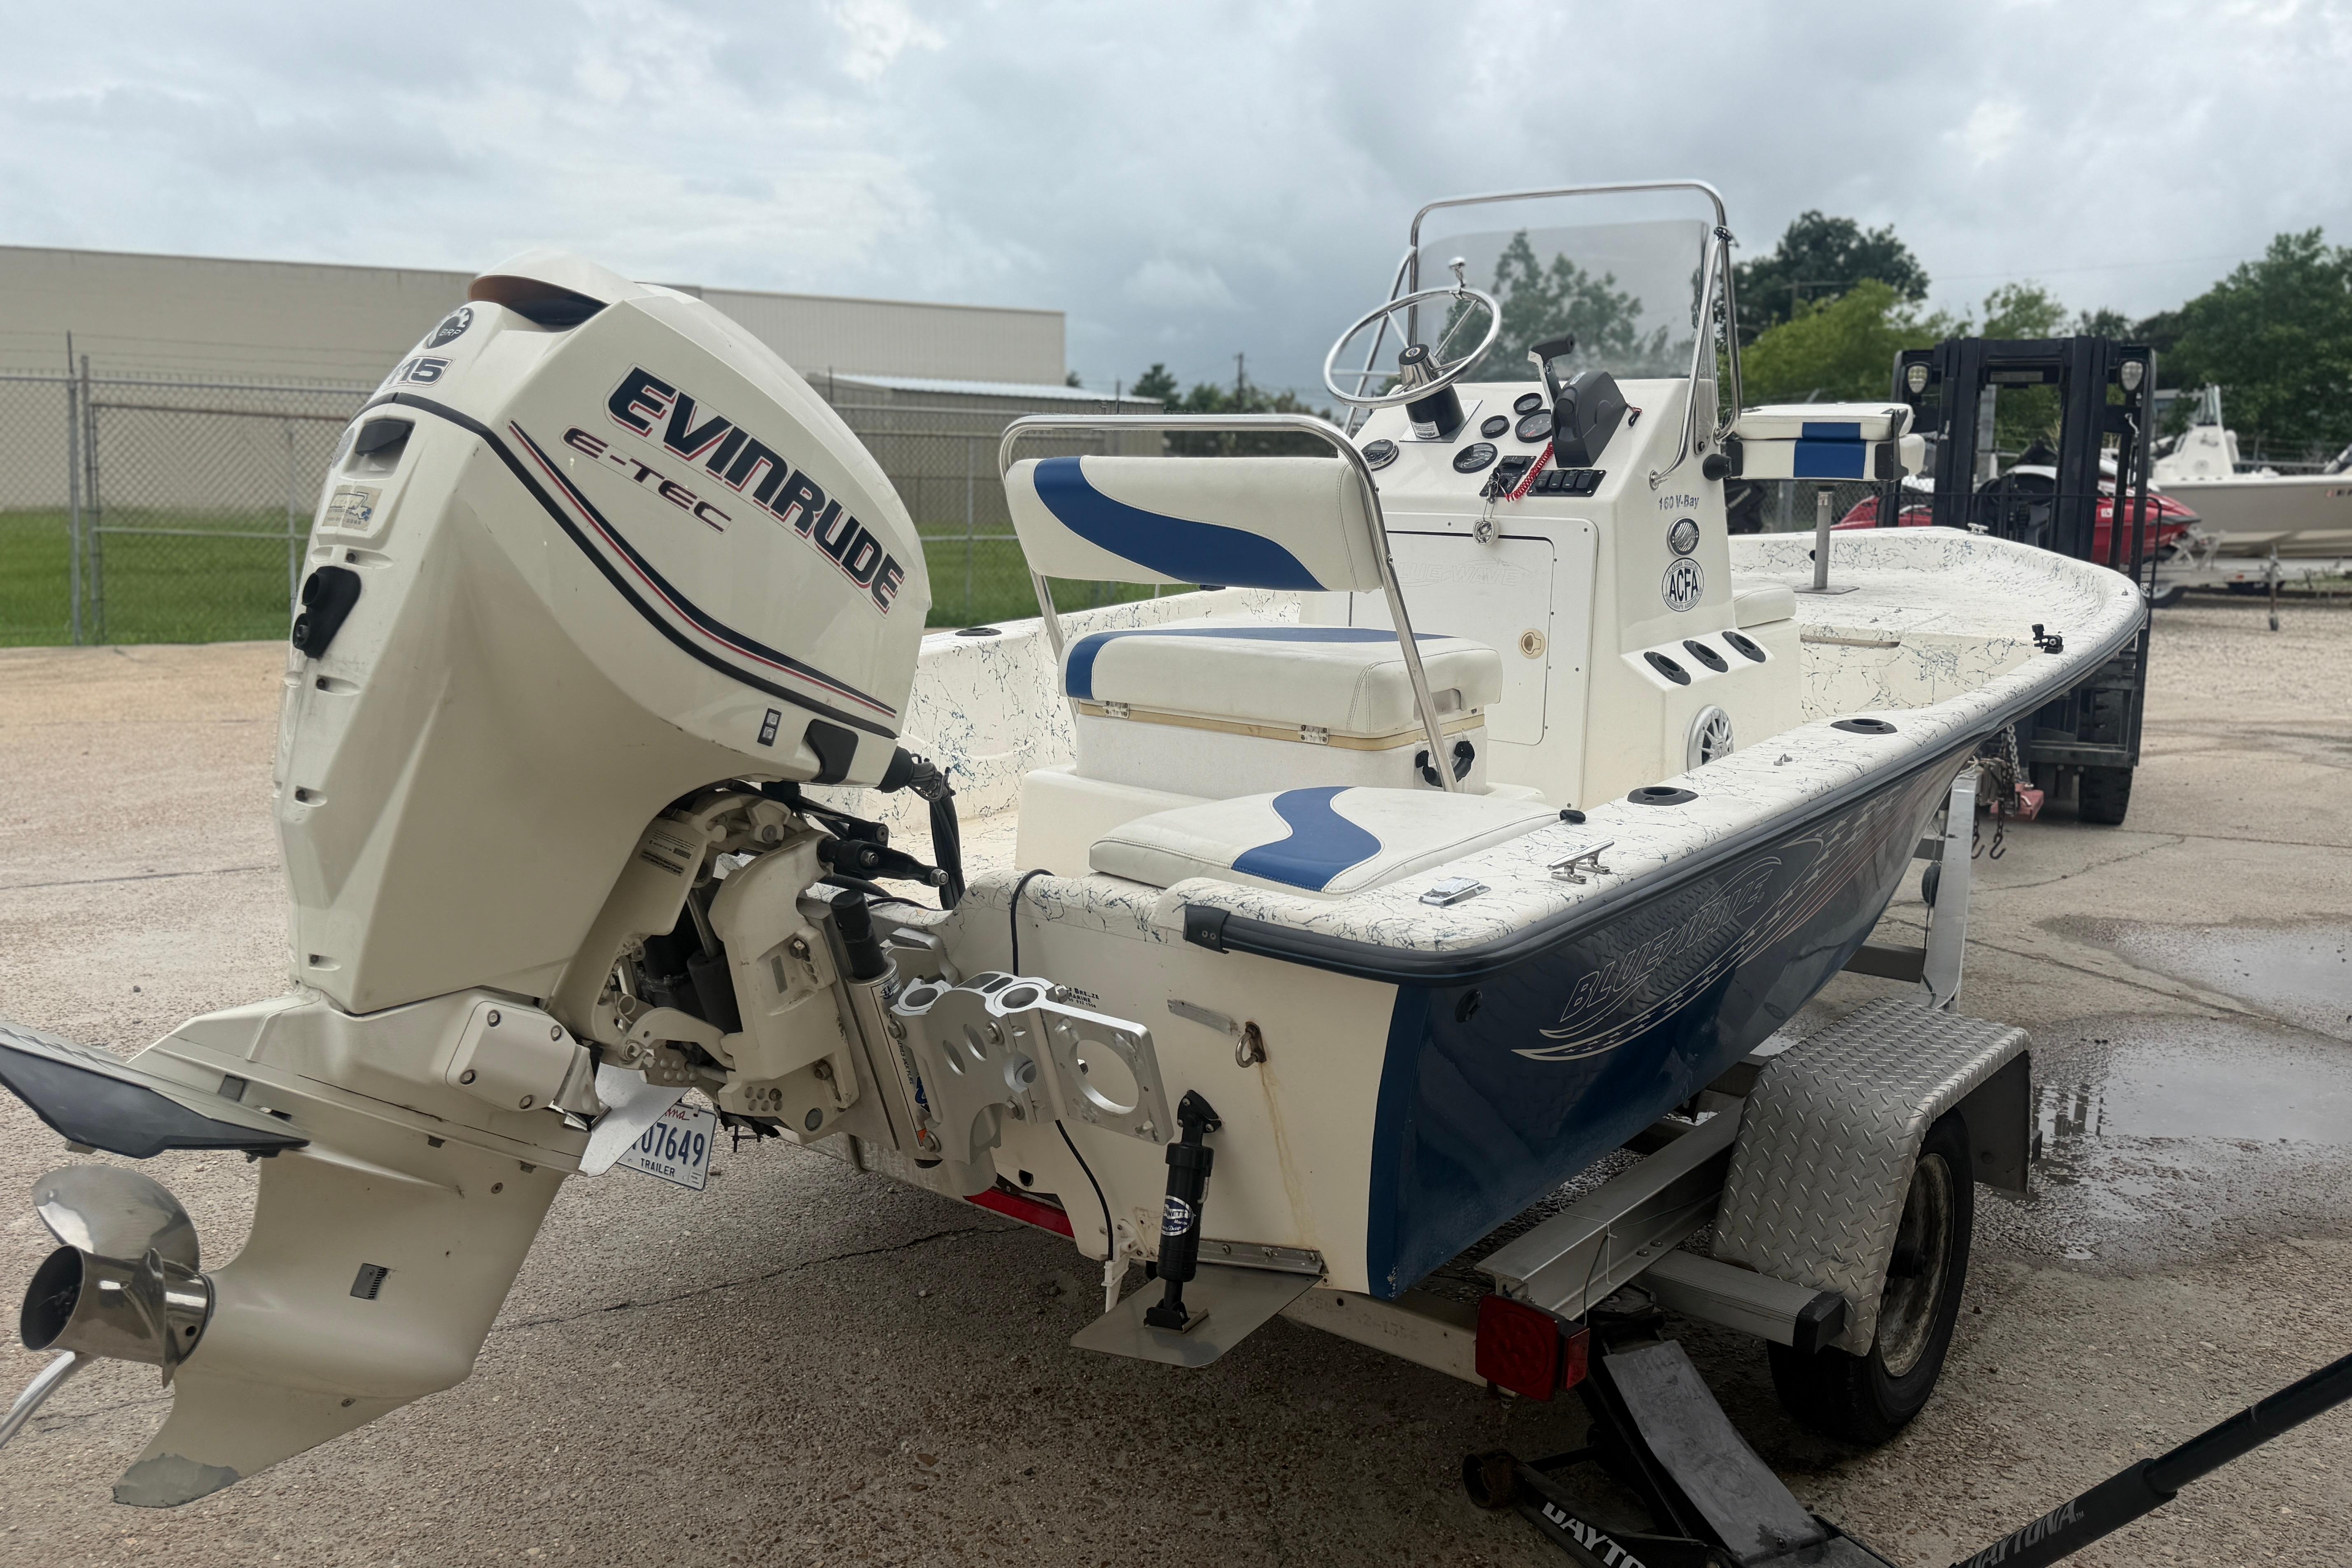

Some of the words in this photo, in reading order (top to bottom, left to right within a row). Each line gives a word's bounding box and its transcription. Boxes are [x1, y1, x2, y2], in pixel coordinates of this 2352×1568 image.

[563, 427, 734, 534] E-TEC
[607, 366, 907, 615] EVINRUDE
[1659, 496, 1674, 510] 160
[1397, 562, 1442, 583] LUE
[1669, 568, 1699, 602] ACFA
[1560, 927, 1674, 1023] BLUE
[1676, 869, 1773, 955] WAVE
[632, 1122, 705, 1167] 07649
[640, 1157, 675, 1177] TRAILER
